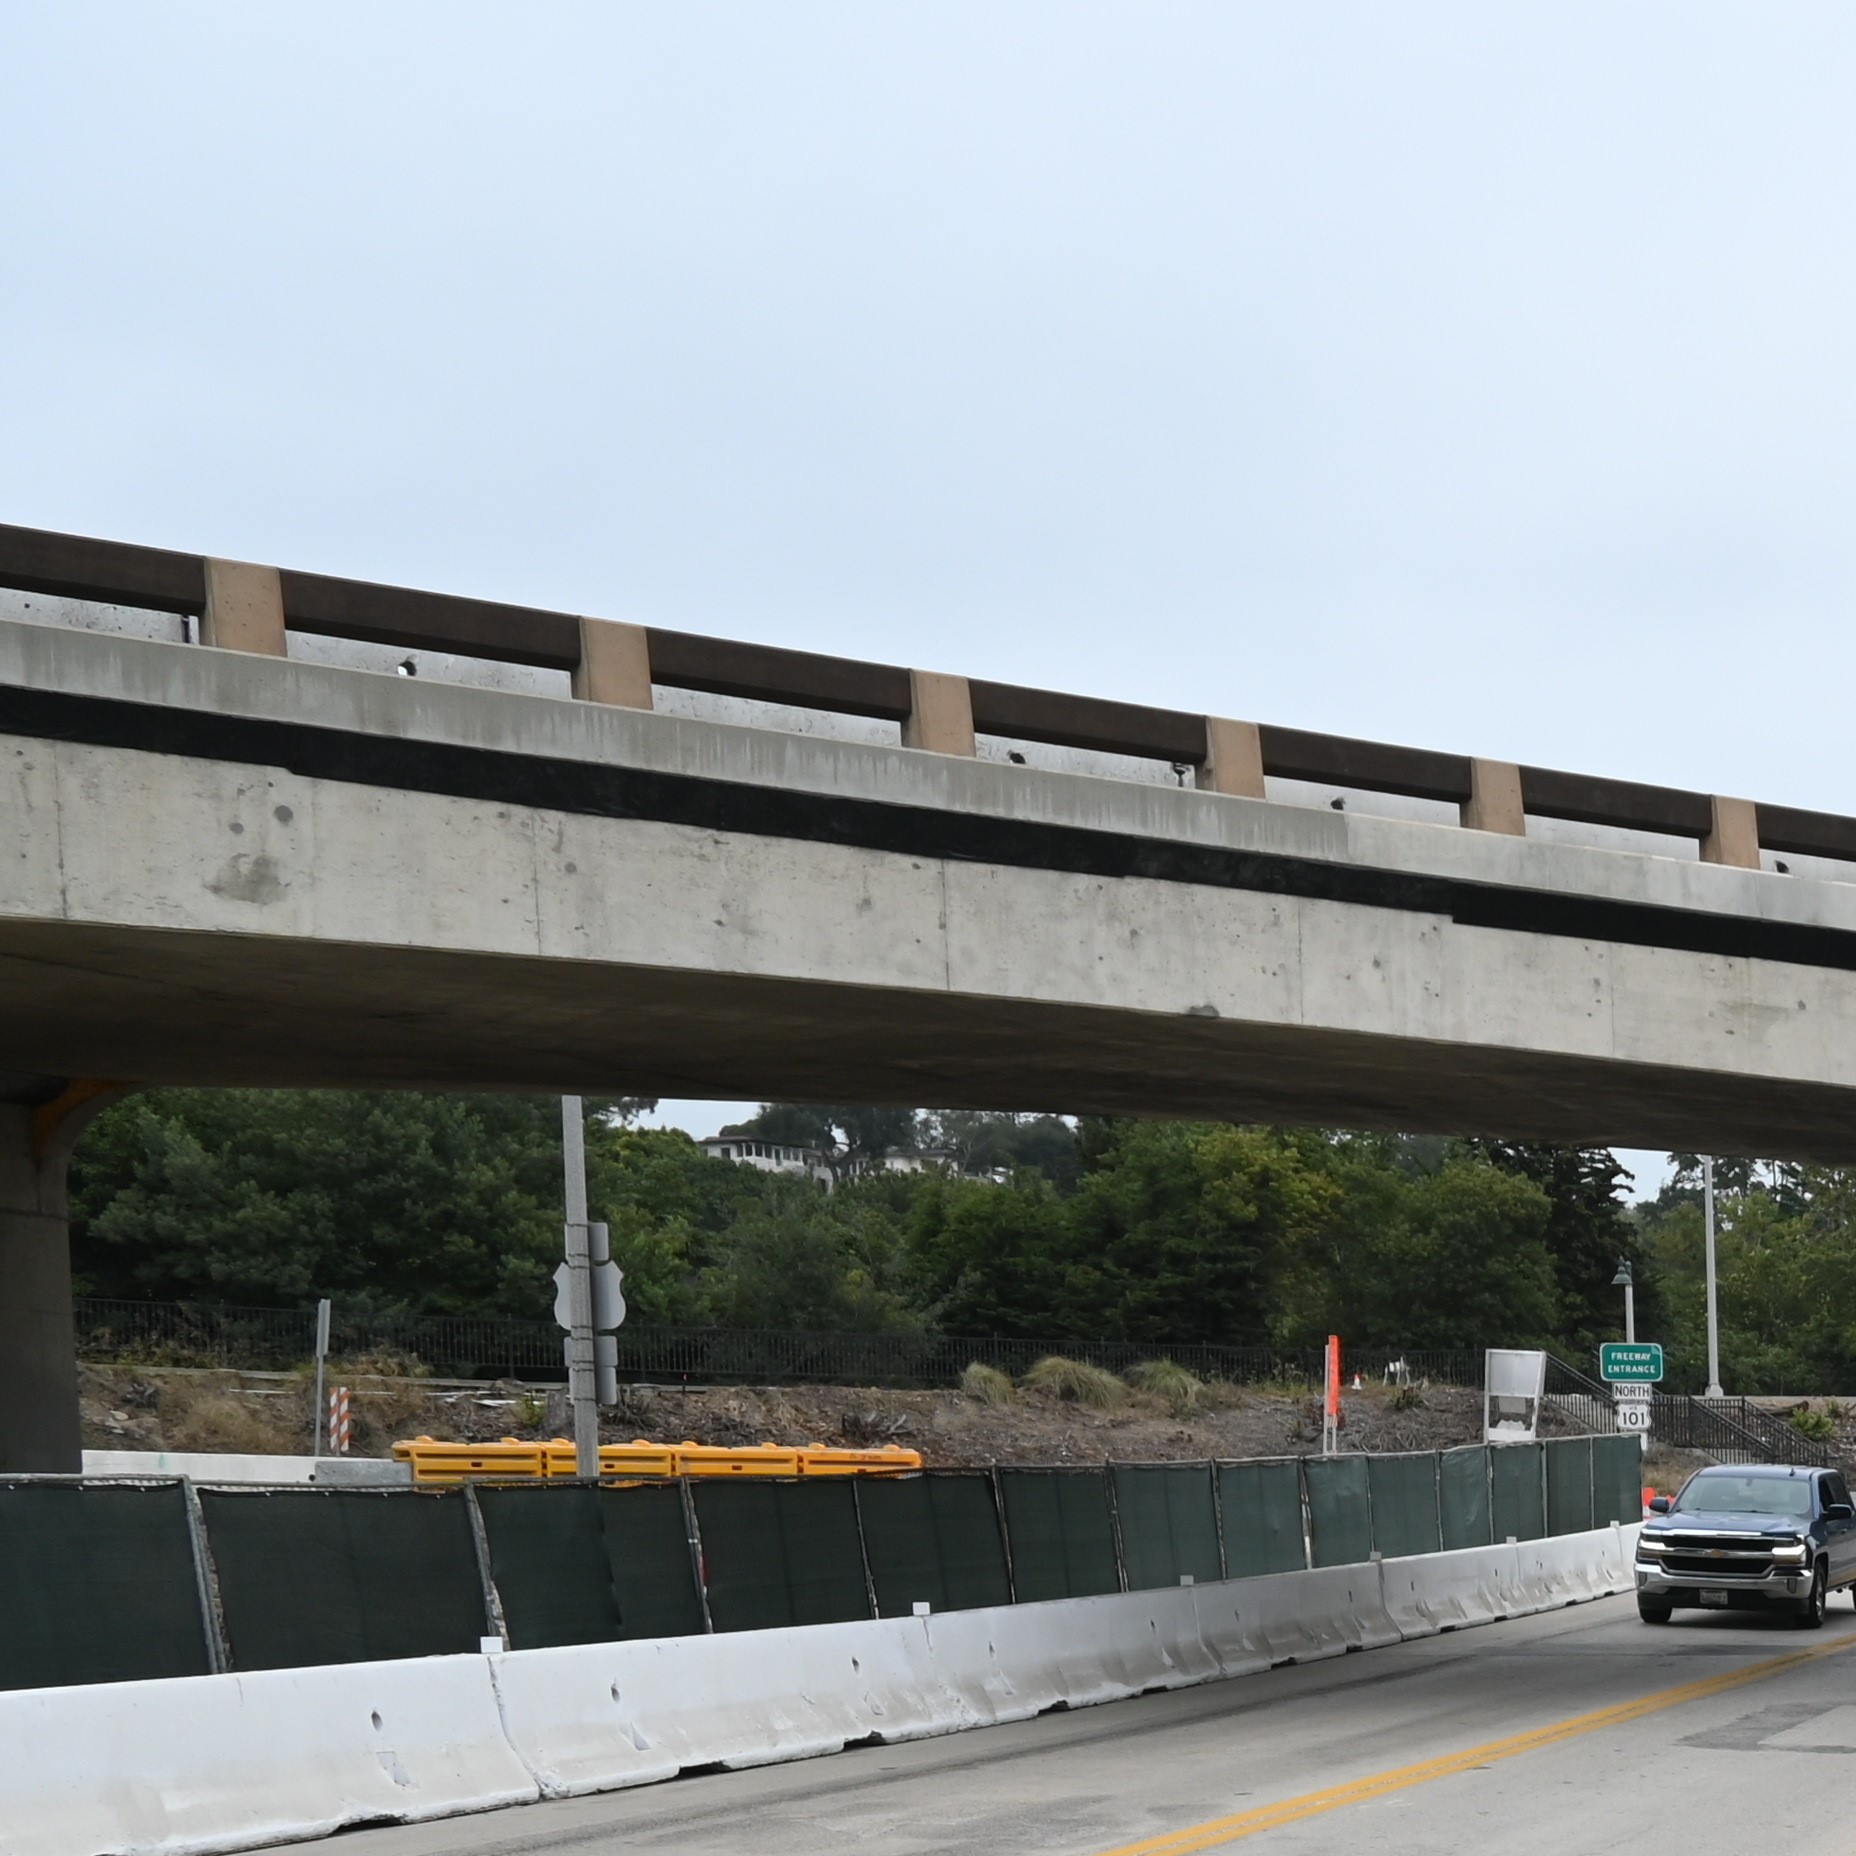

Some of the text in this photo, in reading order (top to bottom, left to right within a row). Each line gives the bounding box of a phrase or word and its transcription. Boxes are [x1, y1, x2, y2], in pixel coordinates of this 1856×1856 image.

[1611, 1352, 1651, 1361] FREEWAY
[1607, 1365, 1656, 1373] ENTRANCE
[1615, 1385, 1650, 1397] NORTH
[1623, 1412, 1645, 1426] 101
